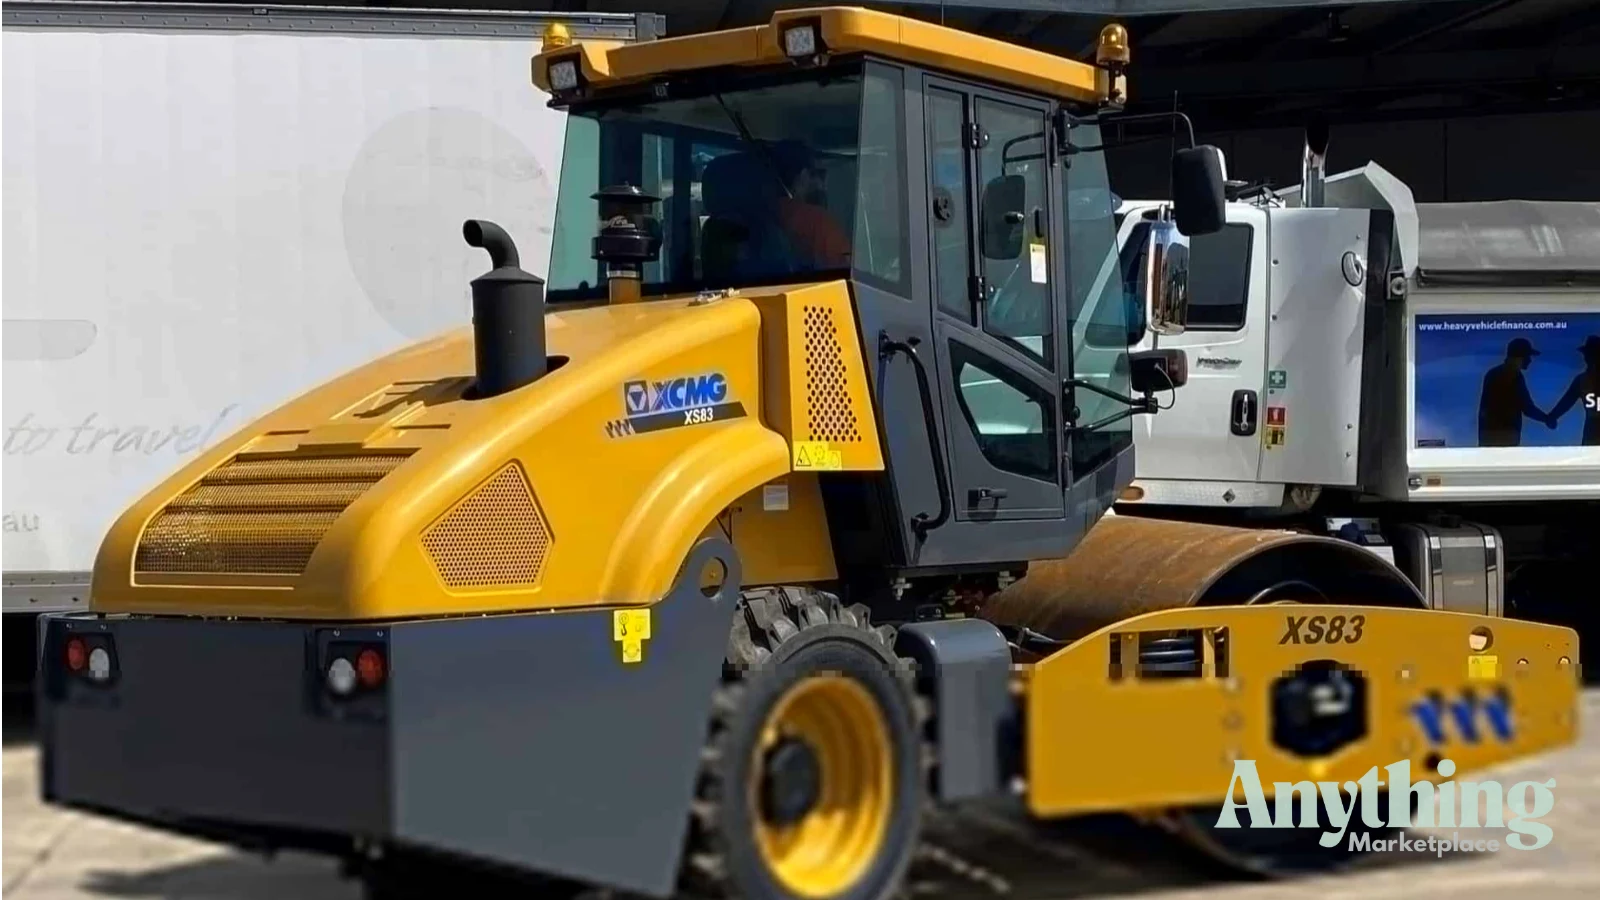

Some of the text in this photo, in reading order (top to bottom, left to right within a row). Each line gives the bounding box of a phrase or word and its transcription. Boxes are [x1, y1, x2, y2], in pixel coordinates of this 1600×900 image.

[1418, 320, 1568, 332] www.heavyvehiclefinance.com.au
[651, 373, 727, 411] XCMG
[684, 407, 714, 425] XS83
[1279, 615, 1365, 645] XS83
